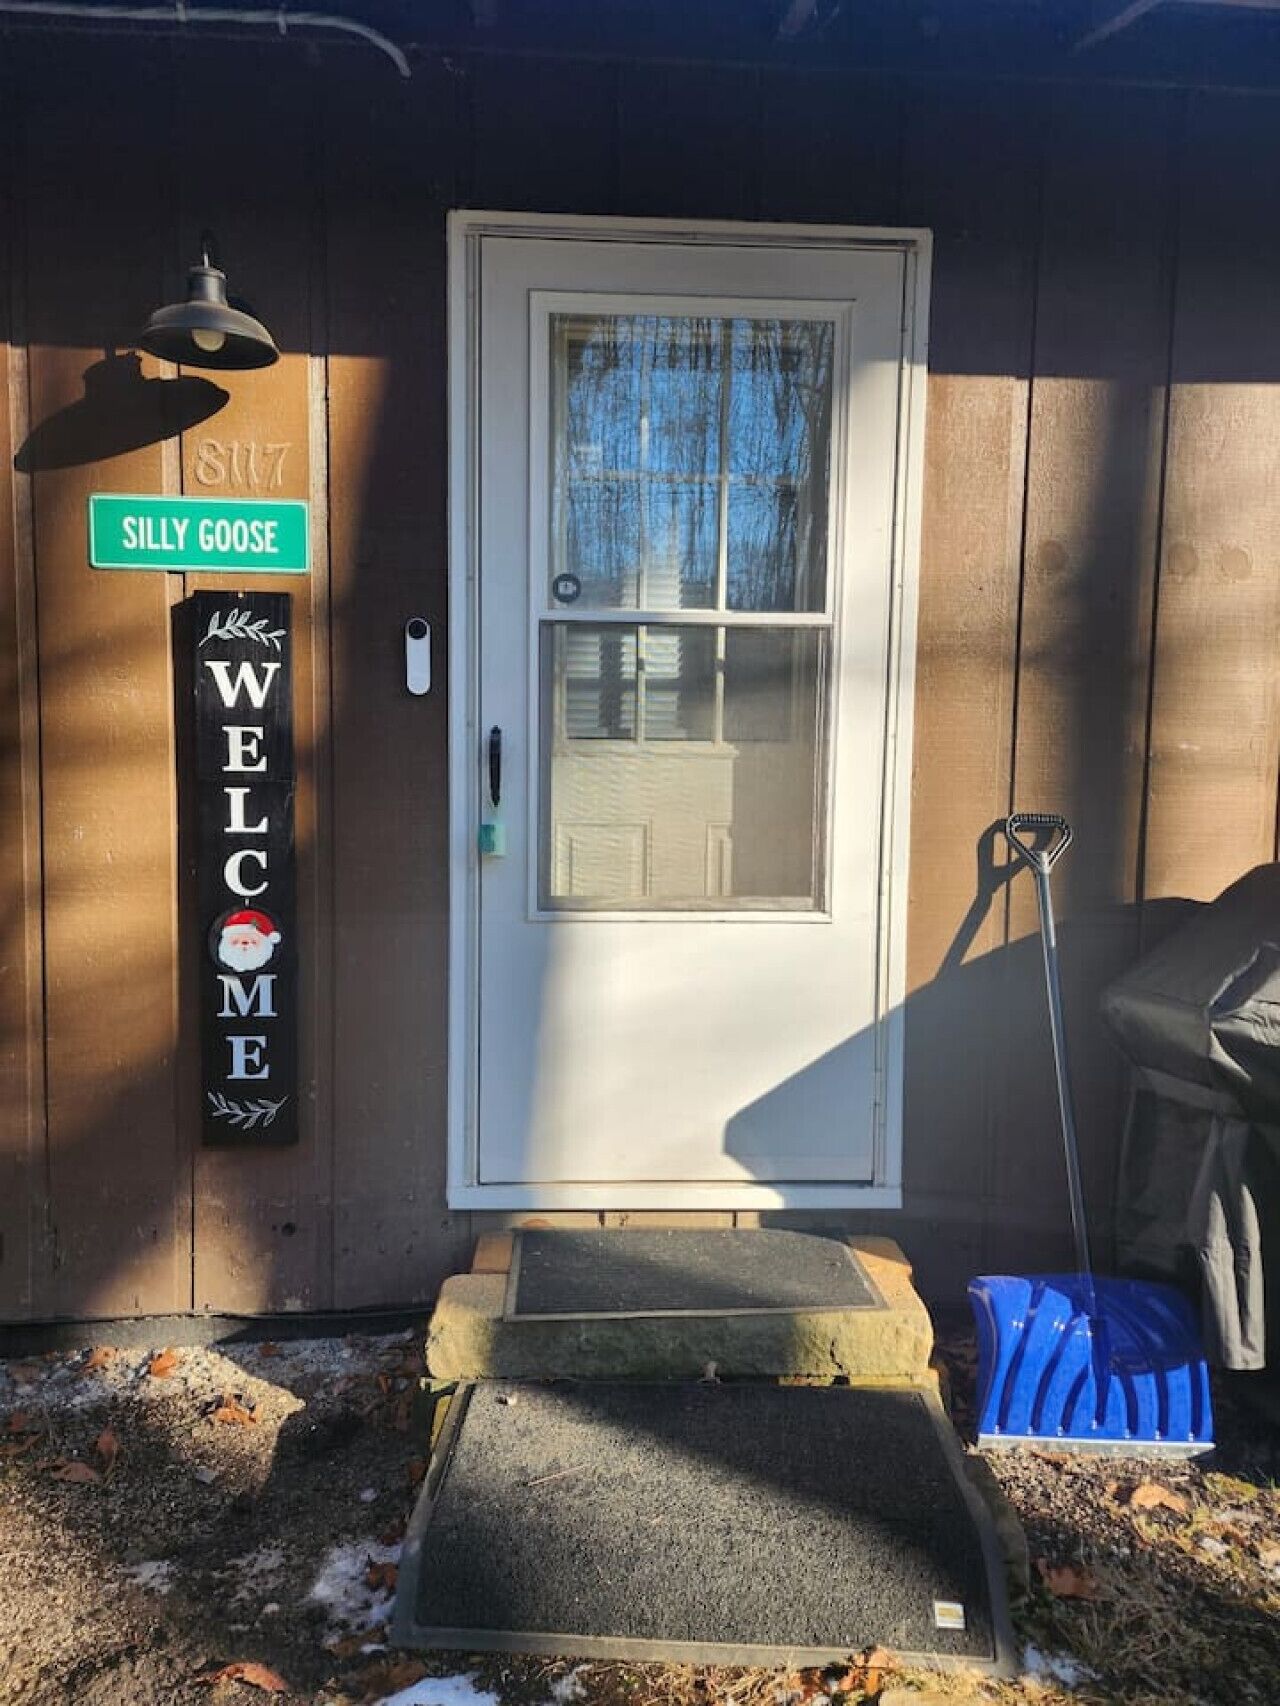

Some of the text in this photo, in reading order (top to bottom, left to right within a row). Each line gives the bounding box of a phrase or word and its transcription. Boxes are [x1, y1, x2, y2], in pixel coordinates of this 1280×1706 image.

[195, 439, 291, 490] 8117
[122, 516, 280, 554] SILLY GOOSE
[205, 660, 281, 1081] WELCME
